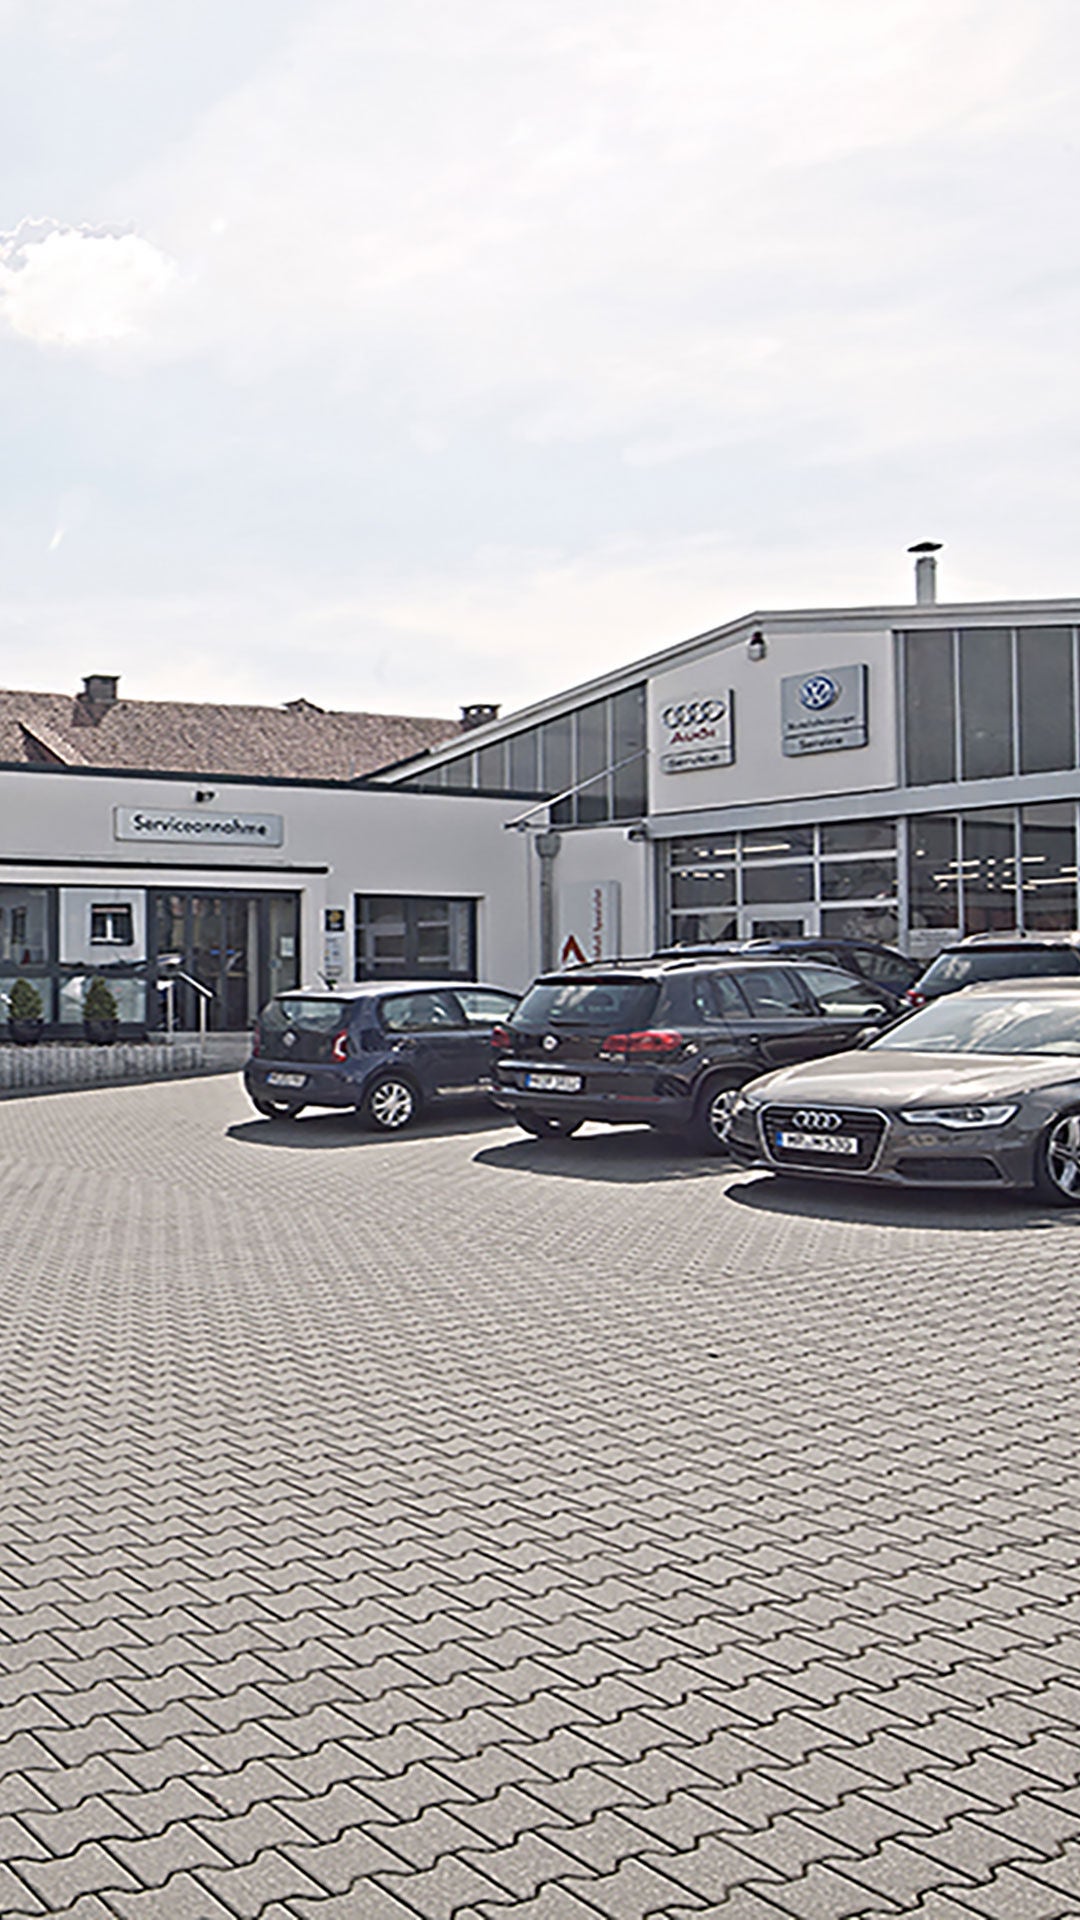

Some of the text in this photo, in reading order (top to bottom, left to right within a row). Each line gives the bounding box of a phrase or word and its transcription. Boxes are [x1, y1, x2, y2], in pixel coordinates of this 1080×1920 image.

[669, 727, 716, 745] Audi
[798, 737, 843, 750] Service
[667, 753, 720, 768] Service
[133, 813, 267, 837] Serviceannahme
